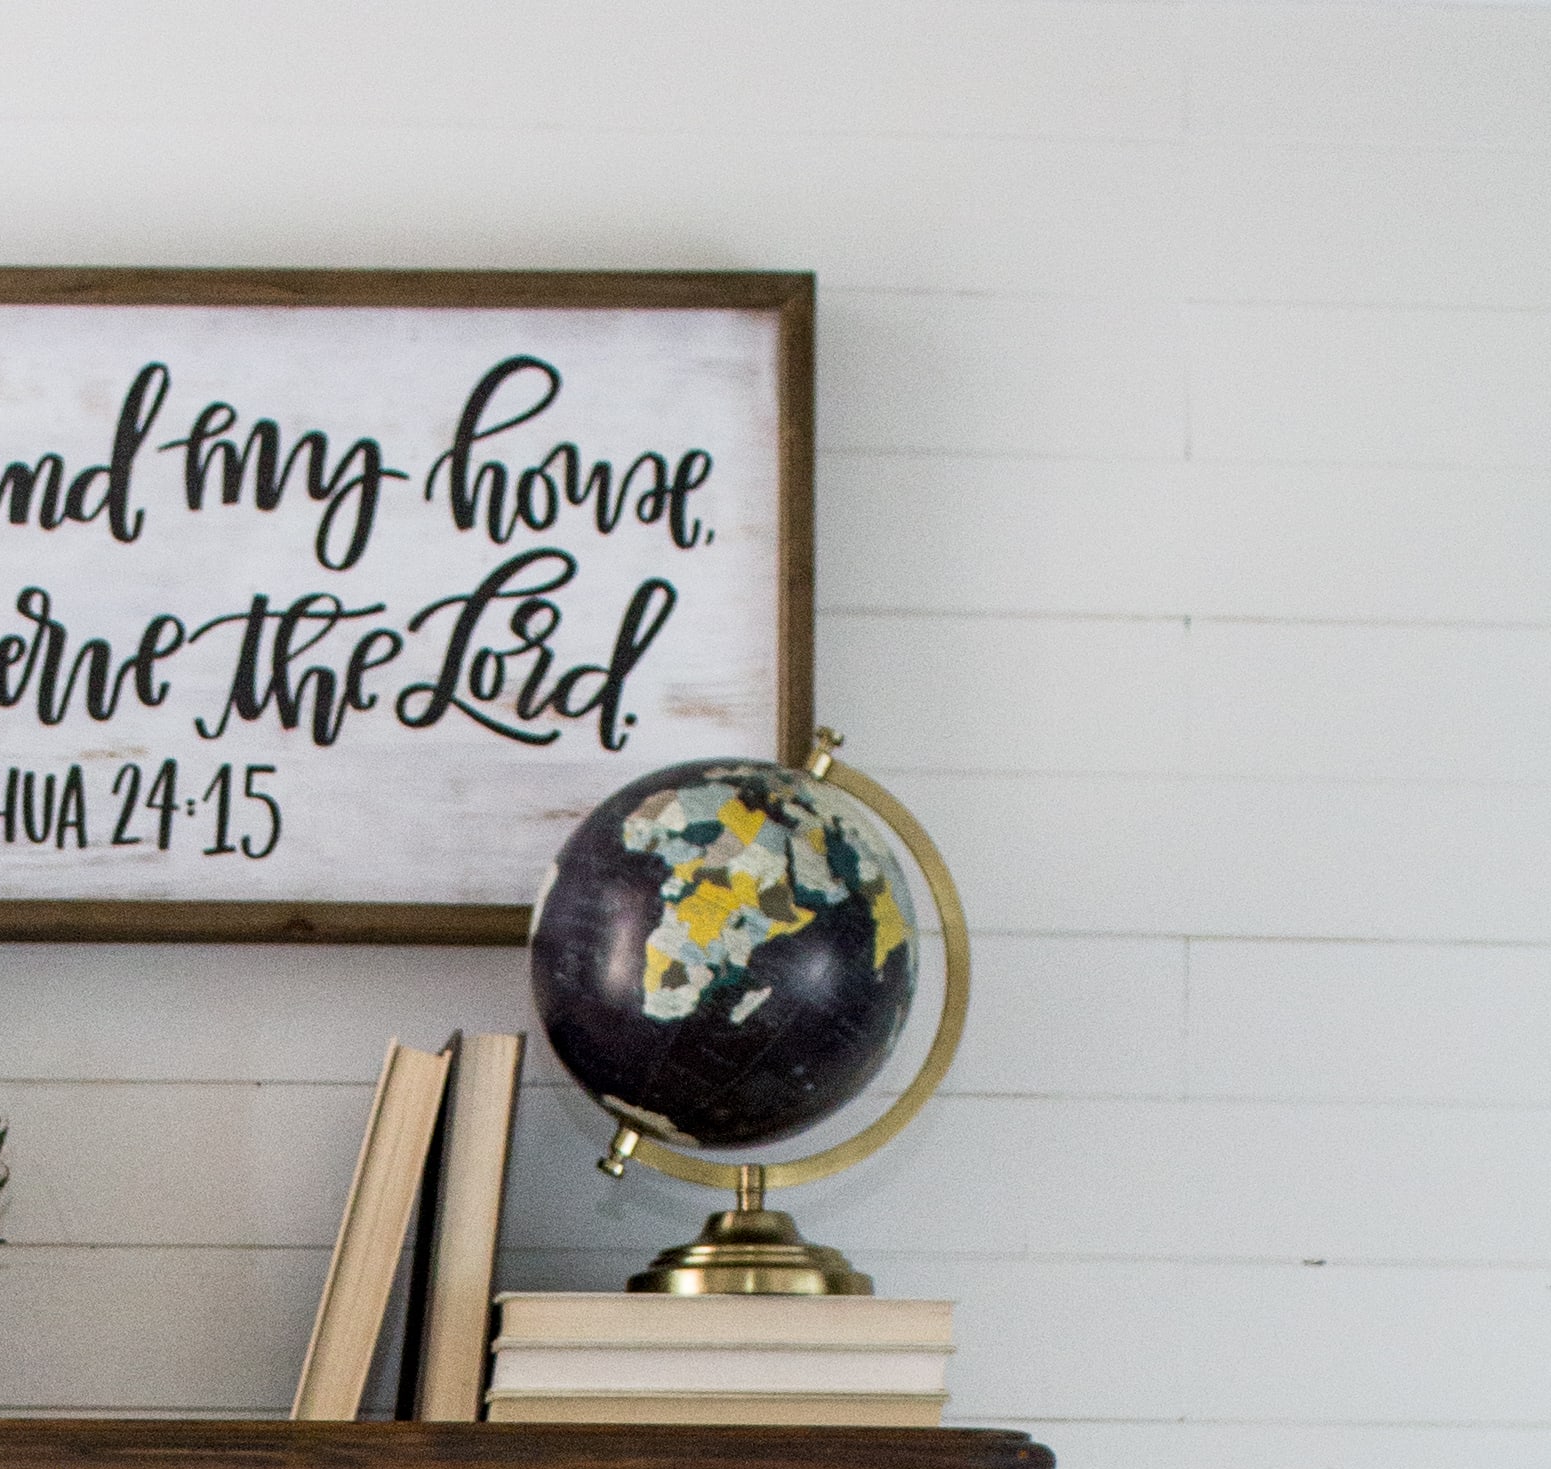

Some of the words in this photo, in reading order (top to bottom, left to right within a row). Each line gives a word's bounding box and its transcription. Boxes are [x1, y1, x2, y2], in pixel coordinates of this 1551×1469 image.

[158, 402, 409, 570] my
[424, 355, 715, 549] house,
[188, 594, 404, 748] the
[395, 549, 677, 752] Lord.
[111, 758, 282, 858] 24:15
